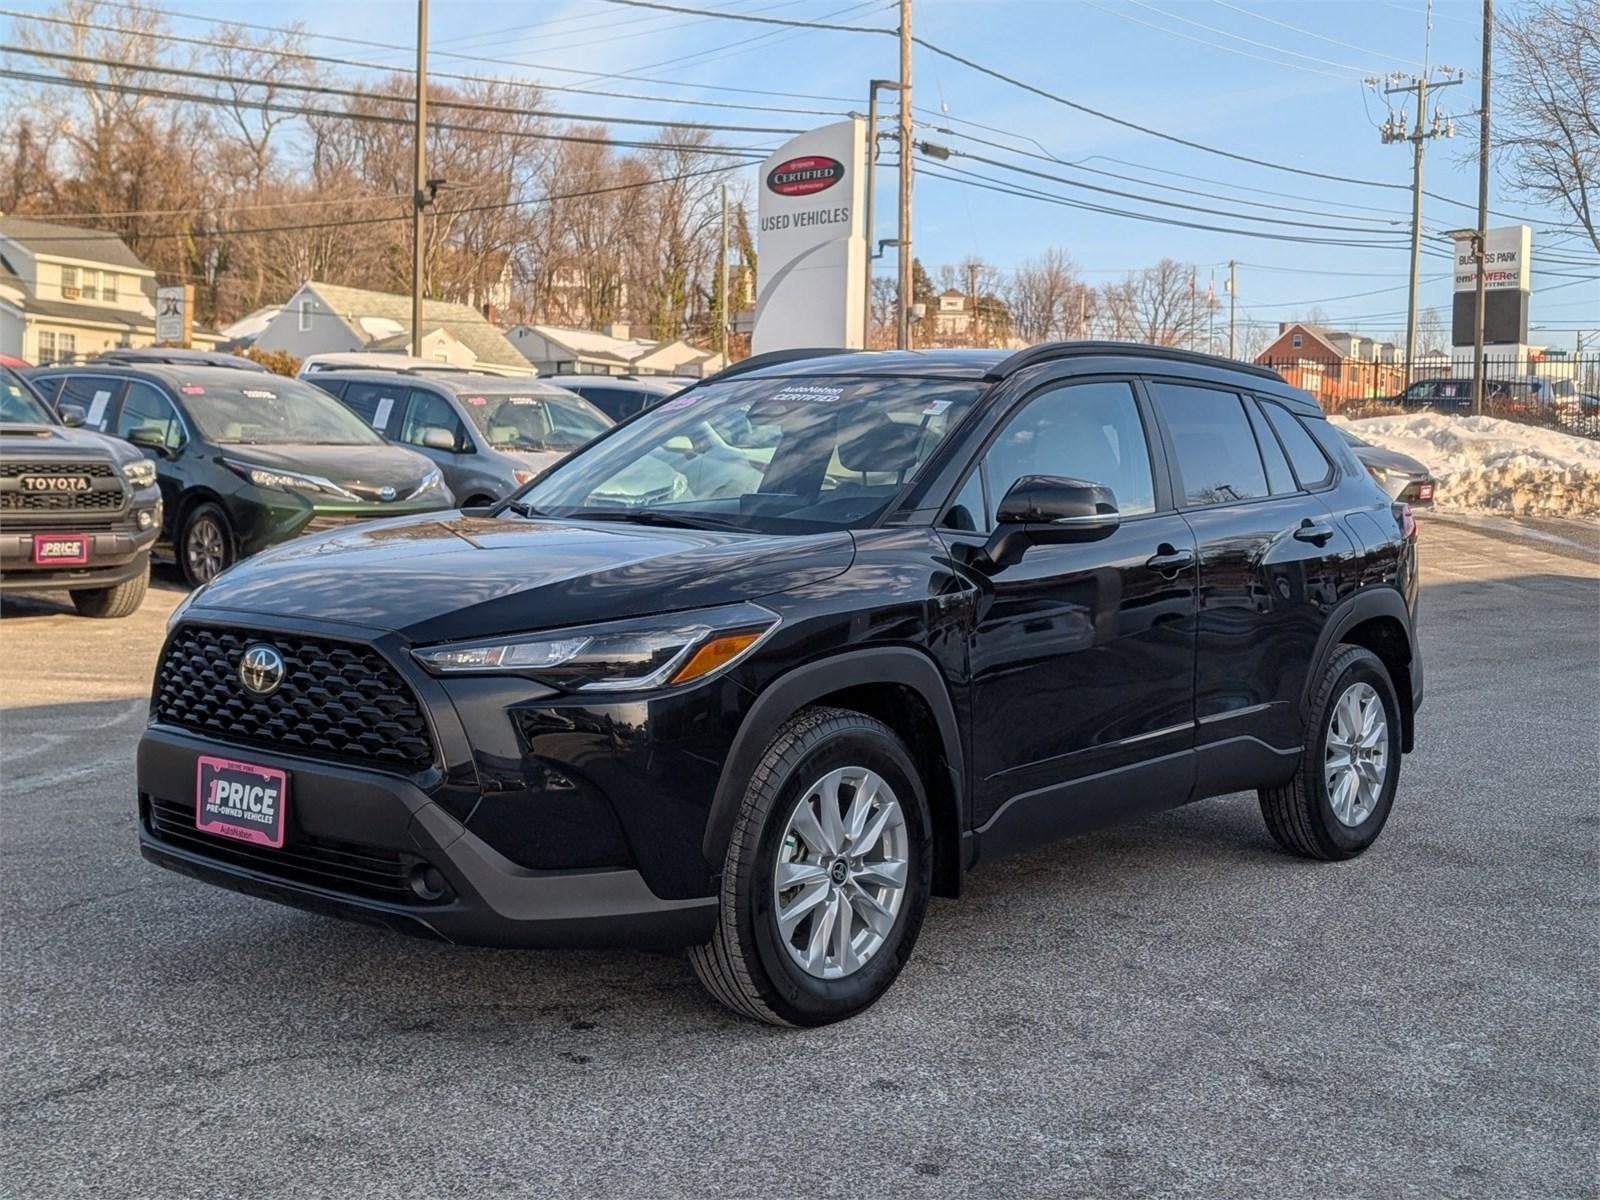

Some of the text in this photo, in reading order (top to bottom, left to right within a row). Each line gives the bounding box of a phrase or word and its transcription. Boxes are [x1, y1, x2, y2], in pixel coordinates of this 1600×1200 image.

[774, 169, 834, 184] CERTIFIED
[761, 207, 849, 231] USED VEHICLES
[1497, 251, 1517, 263] PARK
[25, 478, 87, 490] TOYOTA
[206, 803, 273, 825] PRE-OWNED VEHICLES
